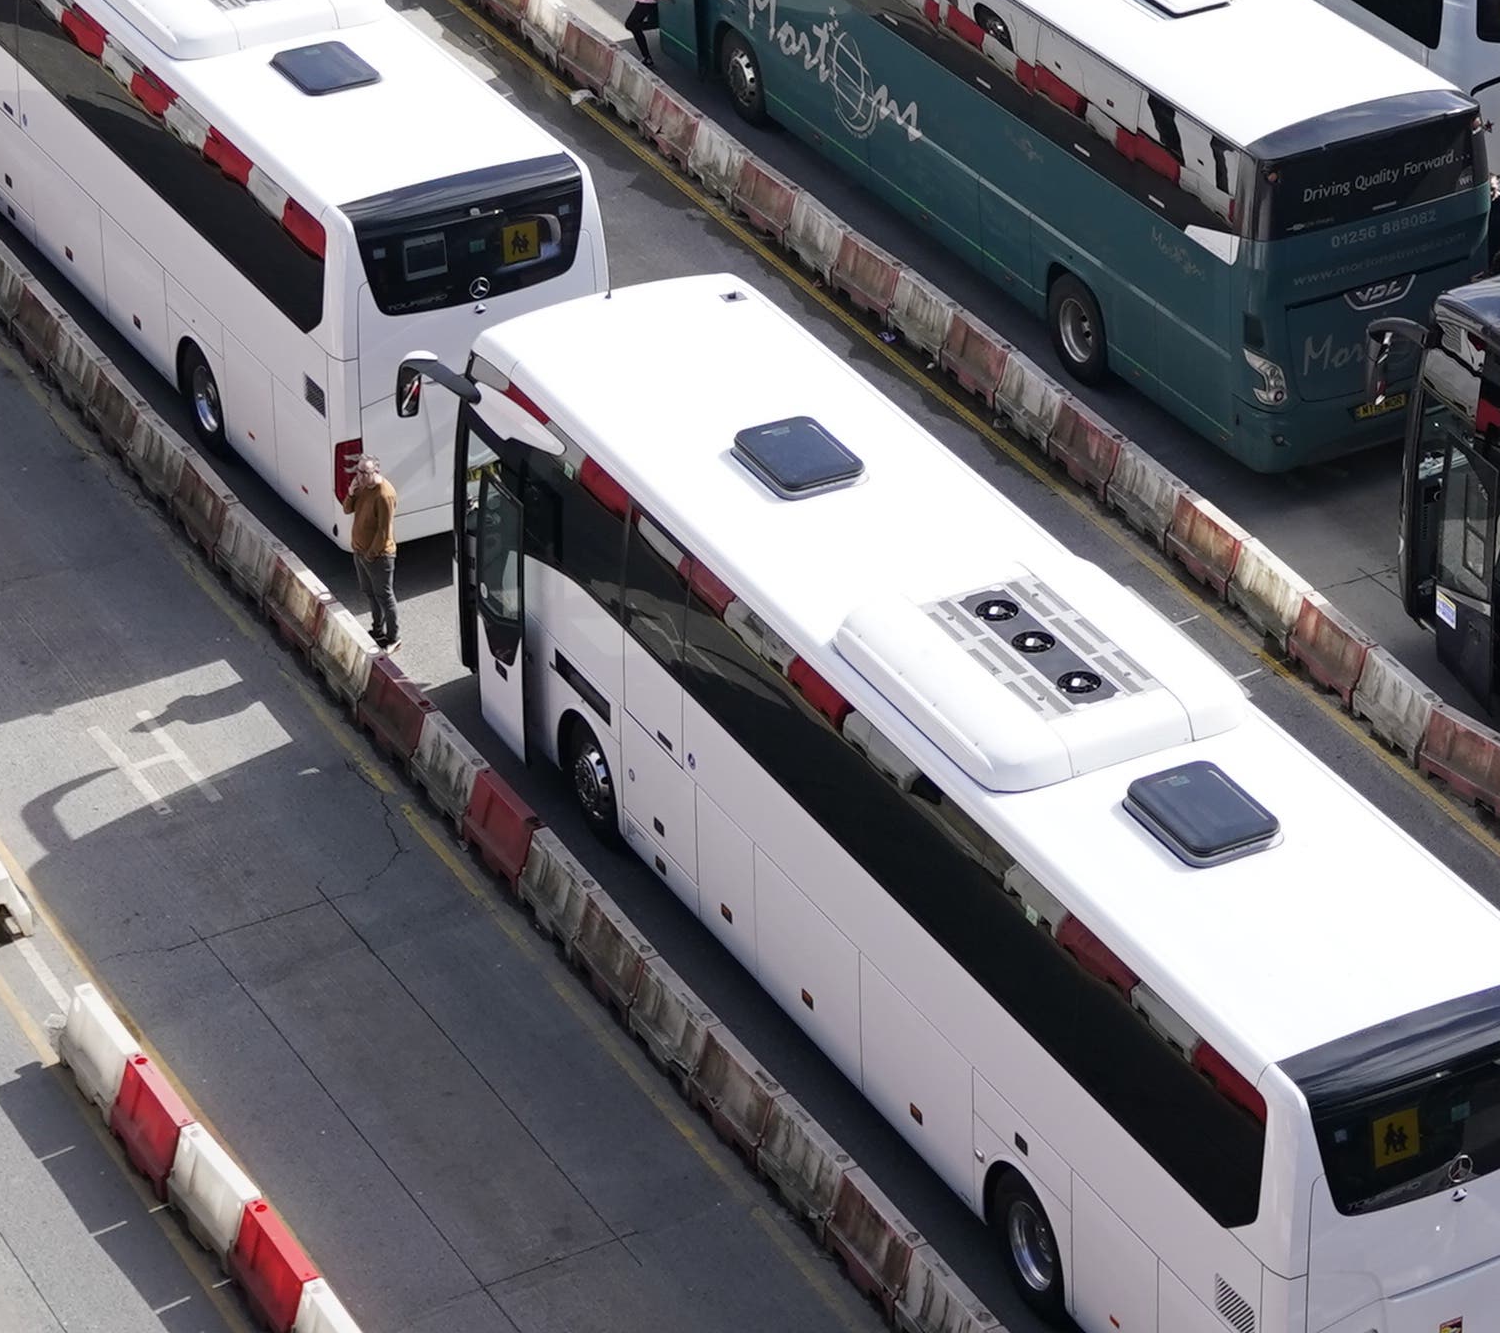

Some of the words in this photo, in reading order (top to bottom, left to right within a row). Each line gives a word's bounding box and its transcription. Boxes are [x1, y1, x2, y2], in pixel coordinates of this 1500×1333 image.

[1303, 179, 1351, 203] Driving
[1355, 168, 1399, 193] Quality
[1331, 226, 1377, 248] 01256
[1381, 209, 1437, 235] 889082
[1355, 281, 1403, 304] VDL
[86, 710, 223, 815] H
